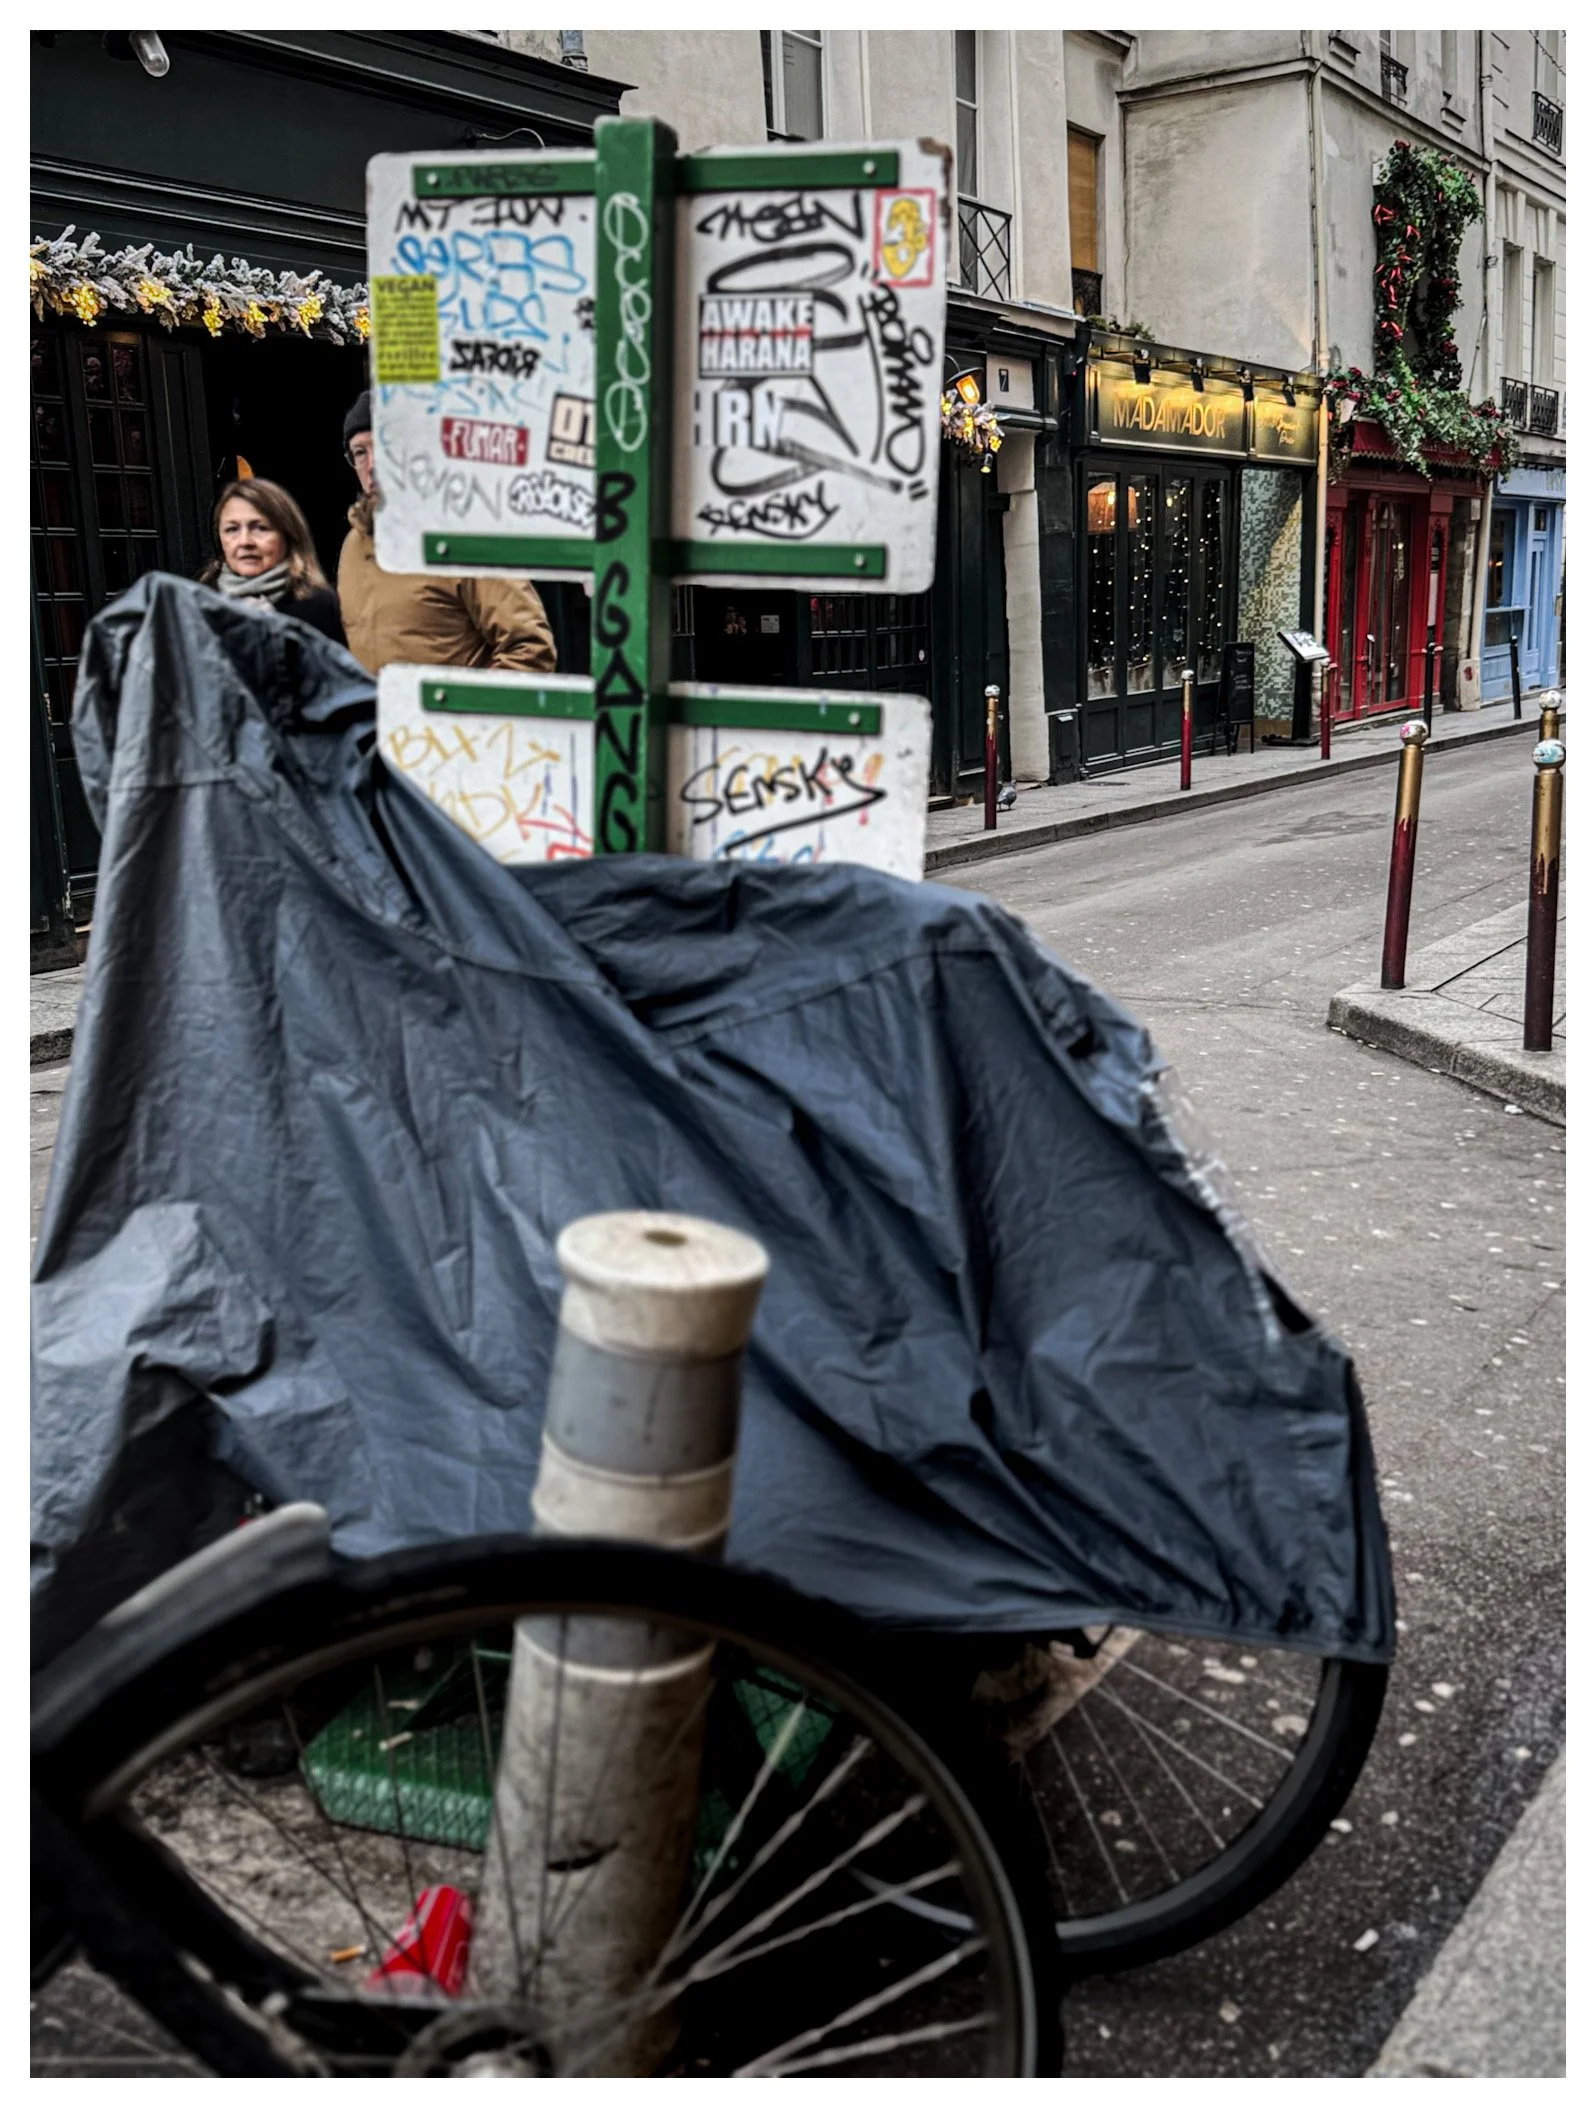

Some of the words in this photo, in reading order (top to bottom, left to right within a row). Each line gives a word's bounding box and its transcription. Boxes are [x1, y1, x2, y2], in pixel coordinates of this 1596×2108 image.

[377, 278, 435, 292] VEGAN
[702, 299, 813, 331] AWAKE
[702, 336, 812, 370] HARANA
[1113, 395, 1226, 440] MADAMADOR
[450, 419, 519, 464] FUMAR
